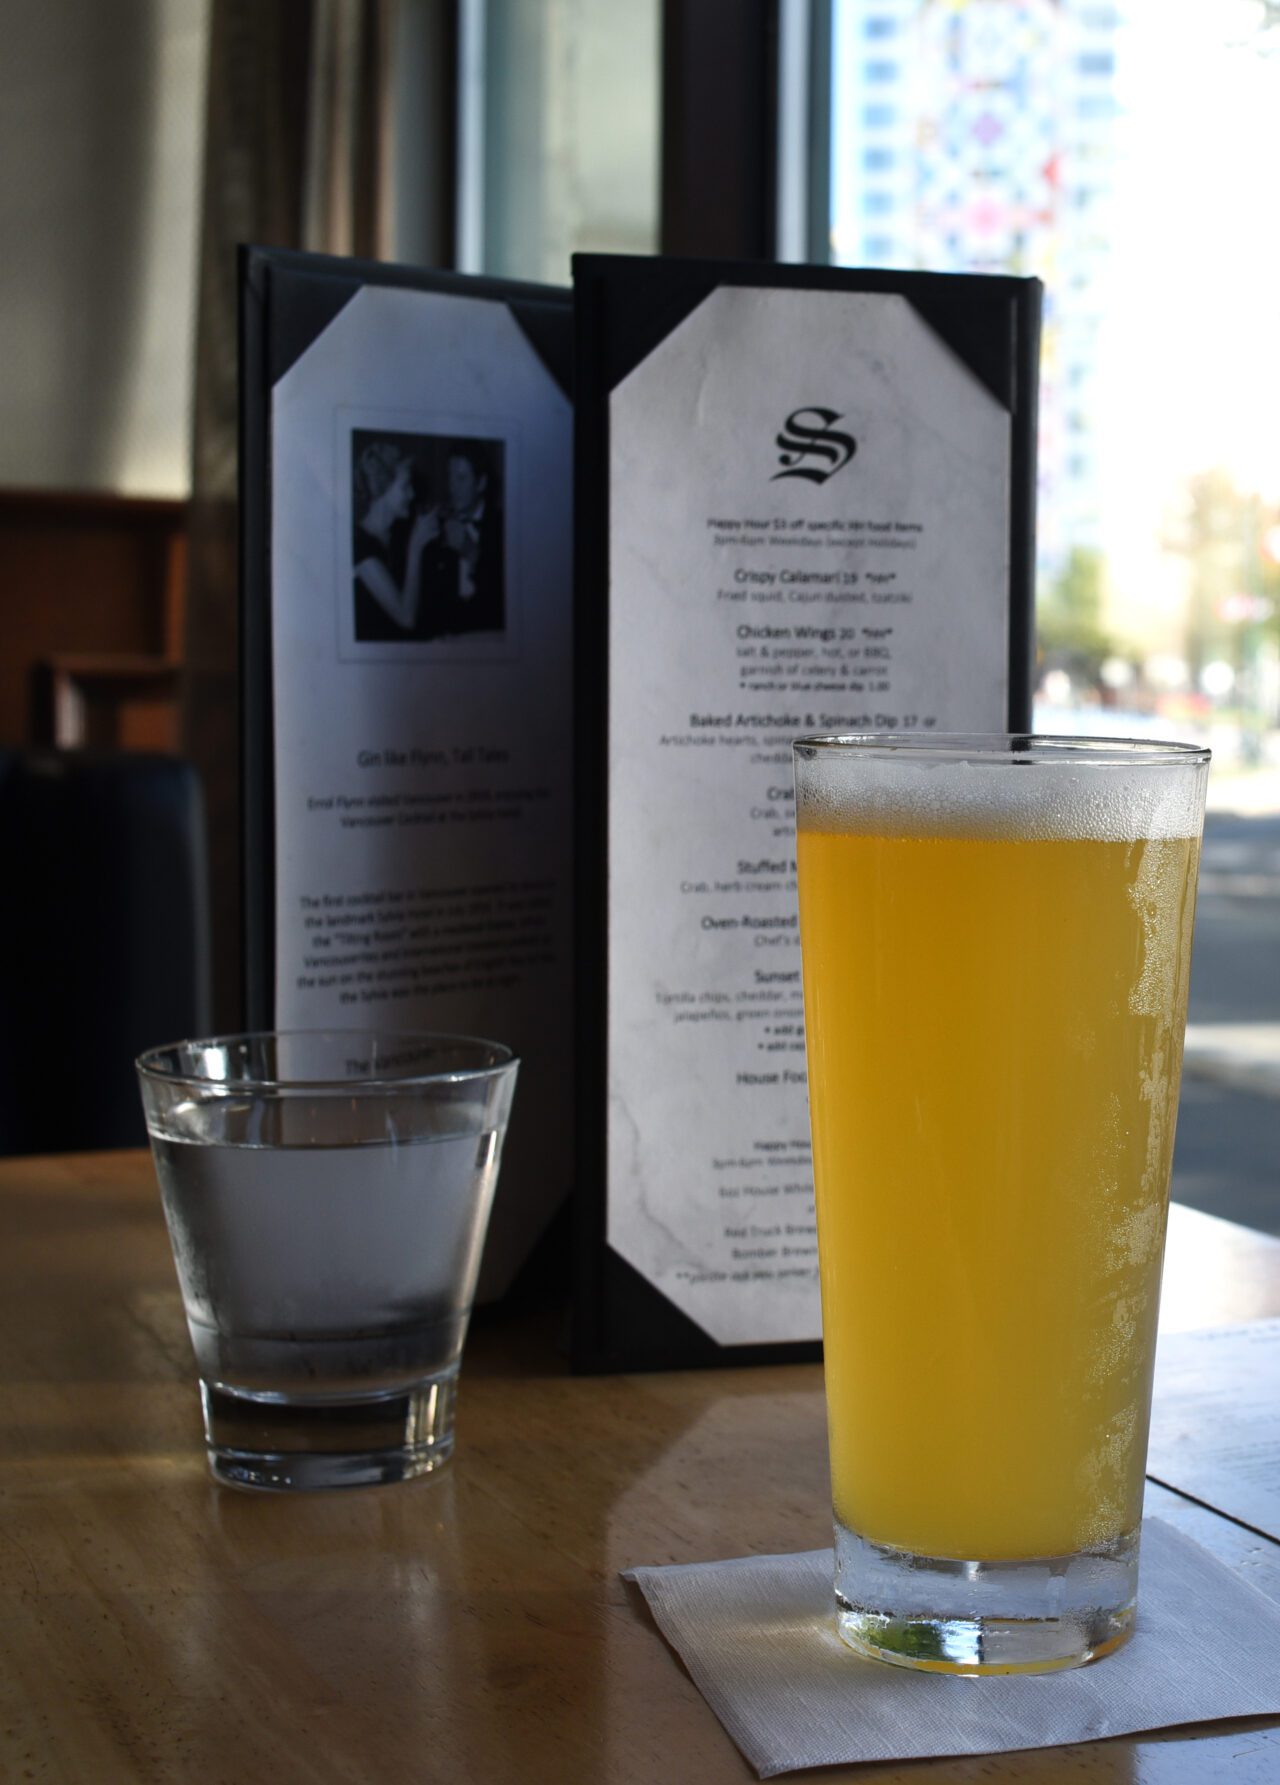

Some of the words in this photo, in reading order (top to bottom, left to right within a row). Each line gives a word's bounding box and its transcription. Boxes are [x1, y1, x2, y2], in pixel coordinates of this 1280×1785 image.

[769, 406, 858, 485] S
[707, 518, 741, 531] Happy
[744, 518, 770, 531] Hour
[790, 518, 805, 531] off
[867, 520, 892, 532] food
[734, 567, 776, 586] Crispy
[779, 567, 841, 584] Calamari
[737, 624, 790, 641] Chicken
[793, 624, 837, 644] Wings
[785, 663, 799, 676] of
[840, 664, 850, 677] &
[689, 713, 732, 729] Baked
[734, 712, 800, 729] Artichoke
[804, 713, 815, 728] &
[818, 713, 872, 731] Spinach
[874, 714, 898, 731] Dip
[357, 749, 382, 769] Gin
[384, 748, 406, 767] like
[737, 859, 788, 875] Stuffed
[754, 969, 800, 984] Sunset
[736, 1071, 780, 1086] House
